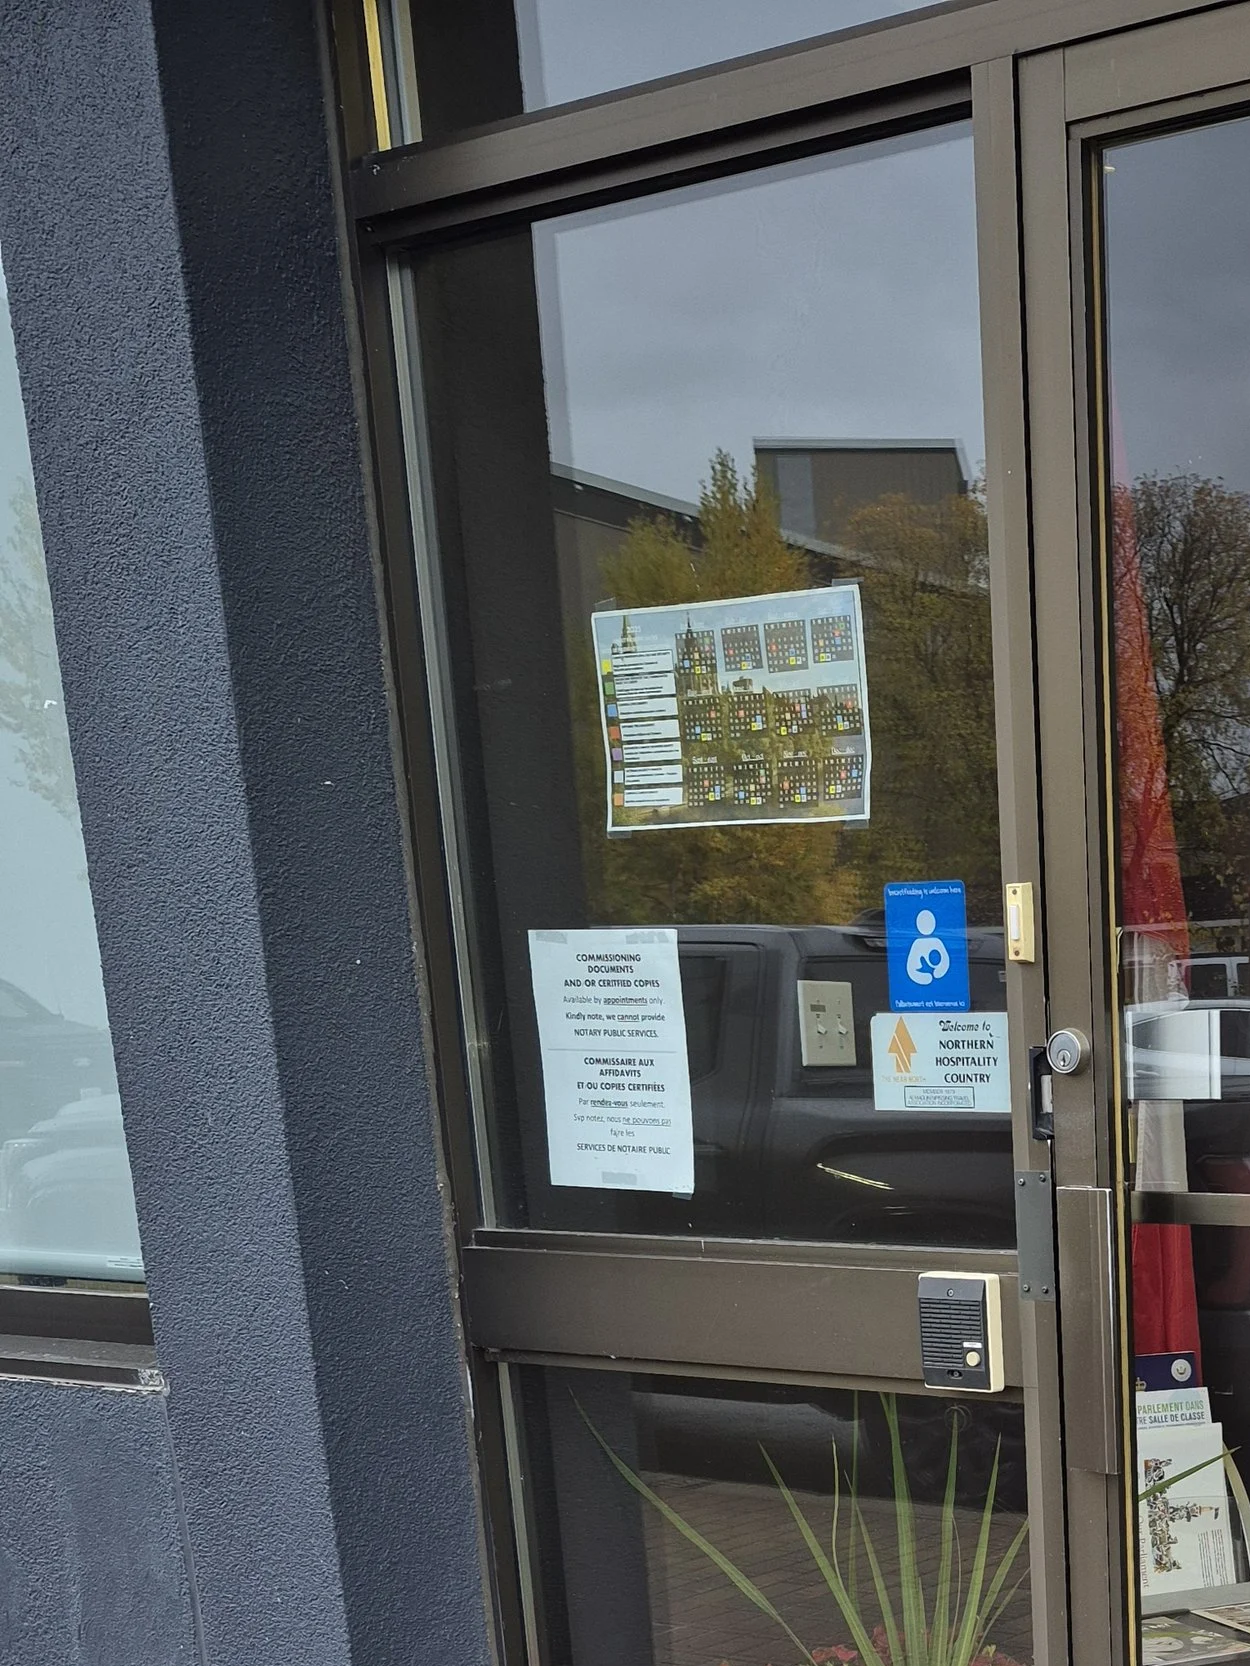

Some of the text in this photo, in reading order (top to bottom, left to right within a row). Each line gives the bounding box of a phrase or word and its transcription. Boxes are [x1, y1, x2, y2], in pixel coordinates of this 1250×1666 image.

[576, 954, 641, 962] COMMISSIONING
[594, 996, 601, 1004] by
[604, 996, 647, 1005] appointments
[649, 997, 666, 1005] only.
[566, 1012, 585, 1021] Kindly
[641, 1013, 665, 1022] provide
[939, 1020, 991, 1032] Welcome to
[628, 1030, 659, 1038] SERVICES.
[939, 1040, 994, 1050] NORTHERN
[584, 1057, 636, 1066] COMMISSAIRE
[935, 1057, 998, 1066] HOSPITALITY
[599, 1069, 641, 1077] AFFIDAVITS
[944, 1073, 991, 1083] COUNTRY
[586, 1082, 598, 1090] OU
[600, 1082, 626, 1091] COPIES
[628, 1082, 665, 1092] CERTIFIÉES
[590, 1098, 628, 1107] rendez-vous
[574, 1114, 585, 1122] Svp
[626, 1129, 635, 1137] les
[577, 1143, 606, 1152] SERVICES
[618, 1145, 647, 1153] NOTAIRE
[1137, 1400, 1204, 1414] PARLEMENT DANS
[1149, 1414, 1168, 1424] SALLE
[1170, 1413, 1179, 1422] DE
[1181, 1412, 1204, 1421] CLASSE
[1139, 1538, 1150, 1588] Parliament
